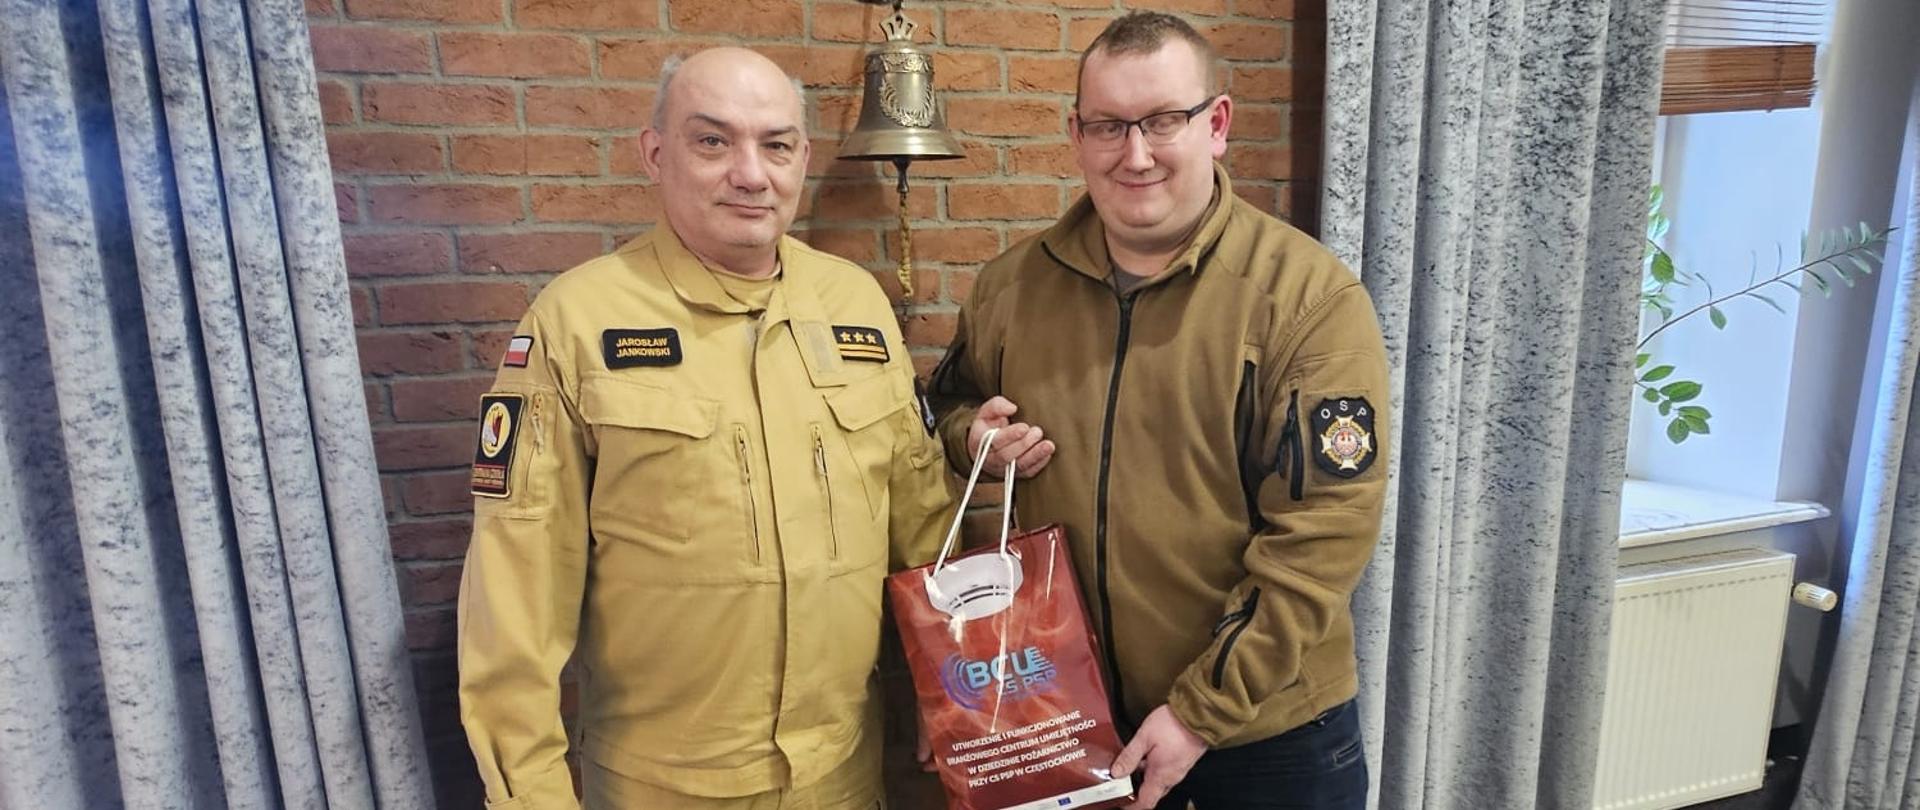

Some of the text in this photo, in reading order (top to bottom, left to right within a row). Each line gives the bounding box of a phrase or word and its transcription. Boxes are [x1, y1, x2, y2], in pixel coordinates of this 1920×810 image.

[616, 337, 668, 347] JAROSŁAW
[616, 347, 671, 358] JANKOWSKI
[965, 646, 1053, 689] BCU
[1023, 669, 1057, 690] PSP
[946, 719, 1097, 766] BRANŻOWEGO CENTRUM UMIEJĘTNOŚCI
[952, 734, 1002, 751] UTWORZENIE
[1006, 710, 1081, 738] FUNKCJONOWANIE
[967, 737, 1080, 775] W DZIEDZINIE POŻARNICTWO
[968, 749, 1087, 788] PRZY CS PSP W CZĘSTOCHOWIE
